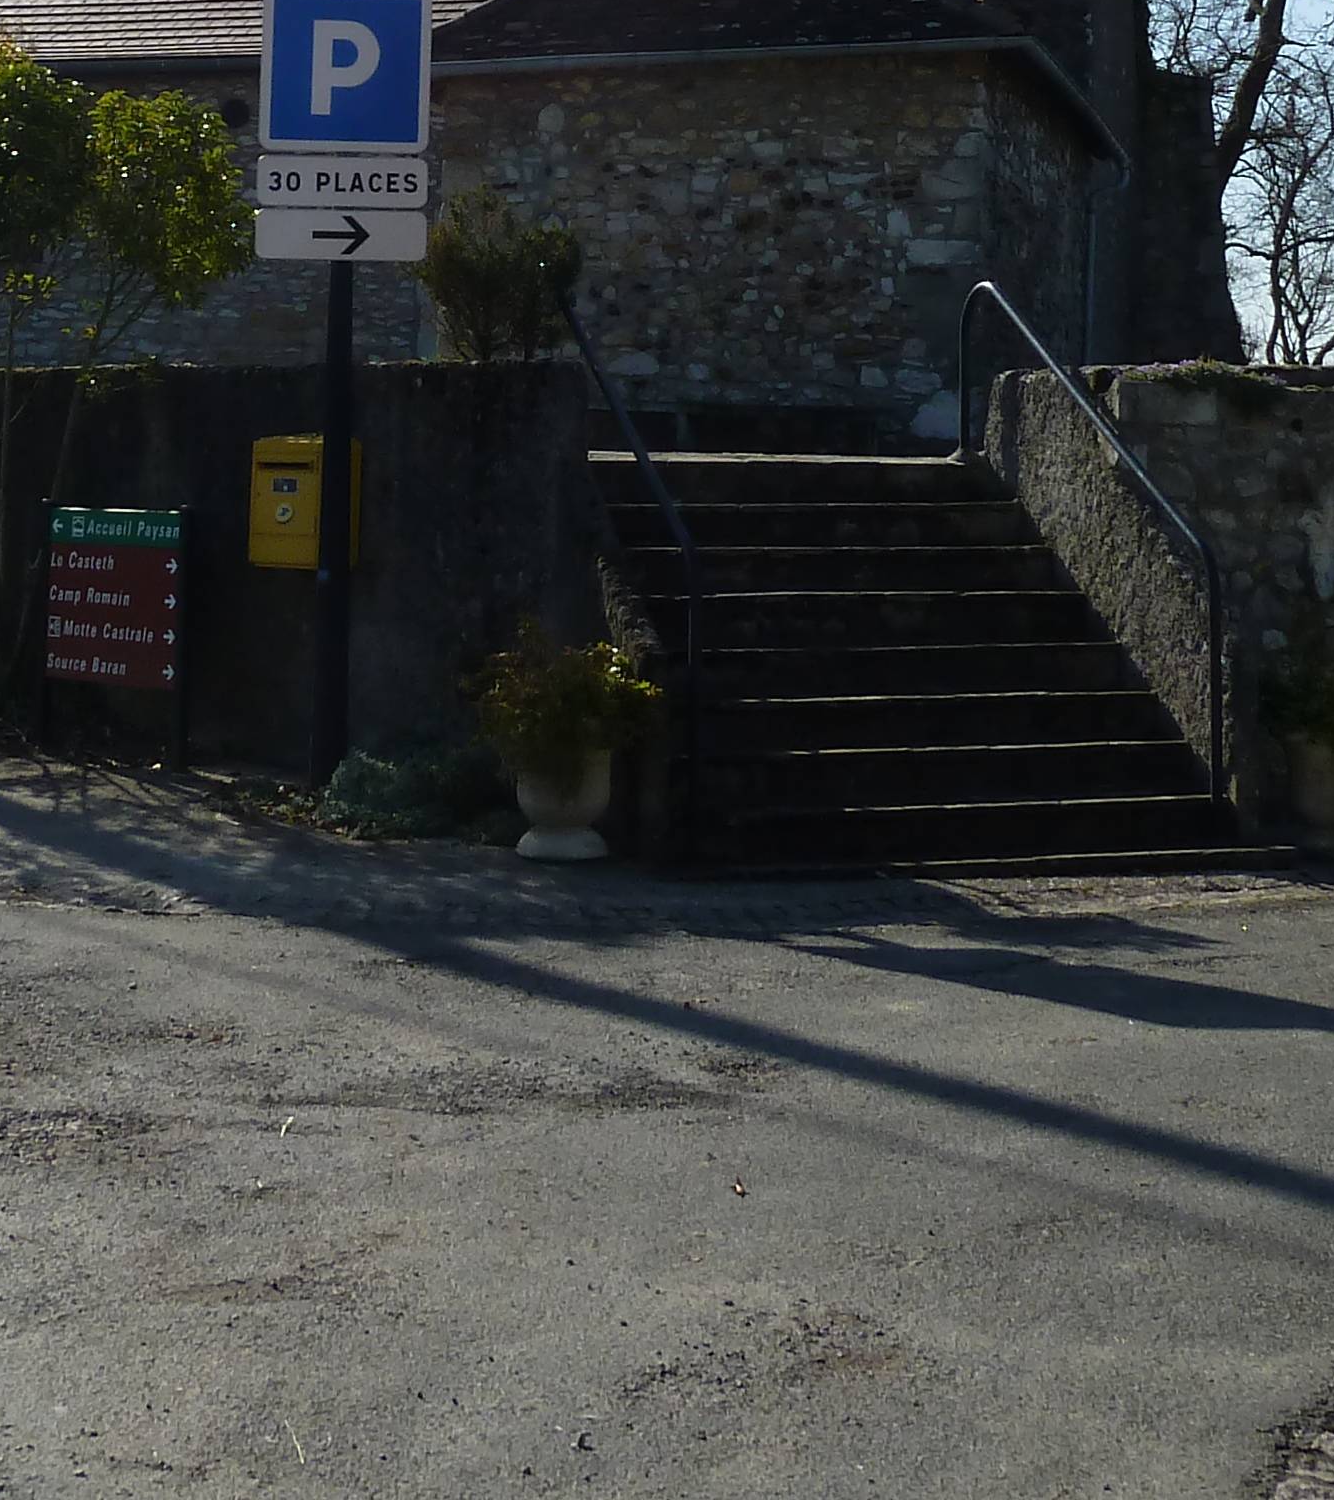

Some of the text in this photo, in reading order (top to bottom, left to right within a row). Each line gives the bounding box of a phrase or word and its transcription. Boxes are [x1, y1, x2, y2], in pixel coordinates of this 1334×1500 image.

[310, 19, 380, 116] P
[269, 172, 418, 193] 30 PLACES
[87, 519, 180, 541] Accueil Paysan
[68, 551, 114, 571] Casteth
[49, 585, 130, 607] Camp Romain
[64, 620, 154, 644] Motte Castrale
[47, 653, 127, 676] Source Baran
